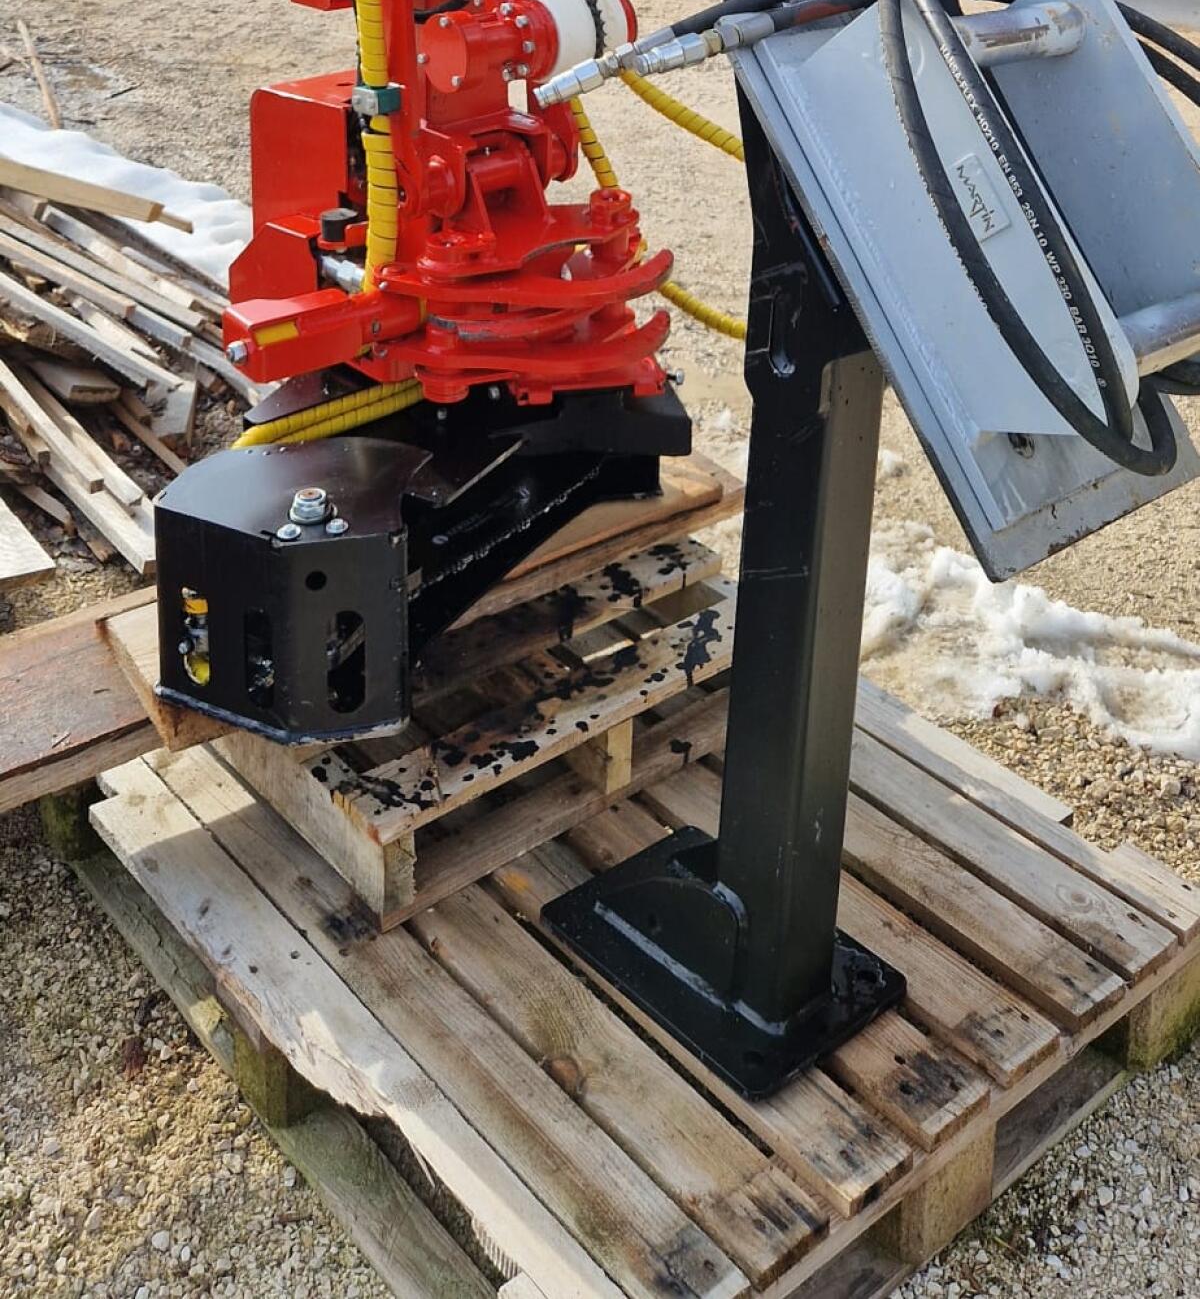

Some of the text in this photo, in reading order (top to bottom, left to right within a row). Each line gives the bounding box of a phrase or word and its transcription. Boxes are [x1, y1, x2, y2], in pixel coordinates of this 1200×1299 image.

[997, 153, 1012, 174] EN
[1007, 175, 1023, 198] 853
[1021, 202, 1040, 230] 2SN
[1036, 231, 1048, 247] 10
[1045, 251, 1061, 275] WP
[1069, 306, 1088, 334] BAR
